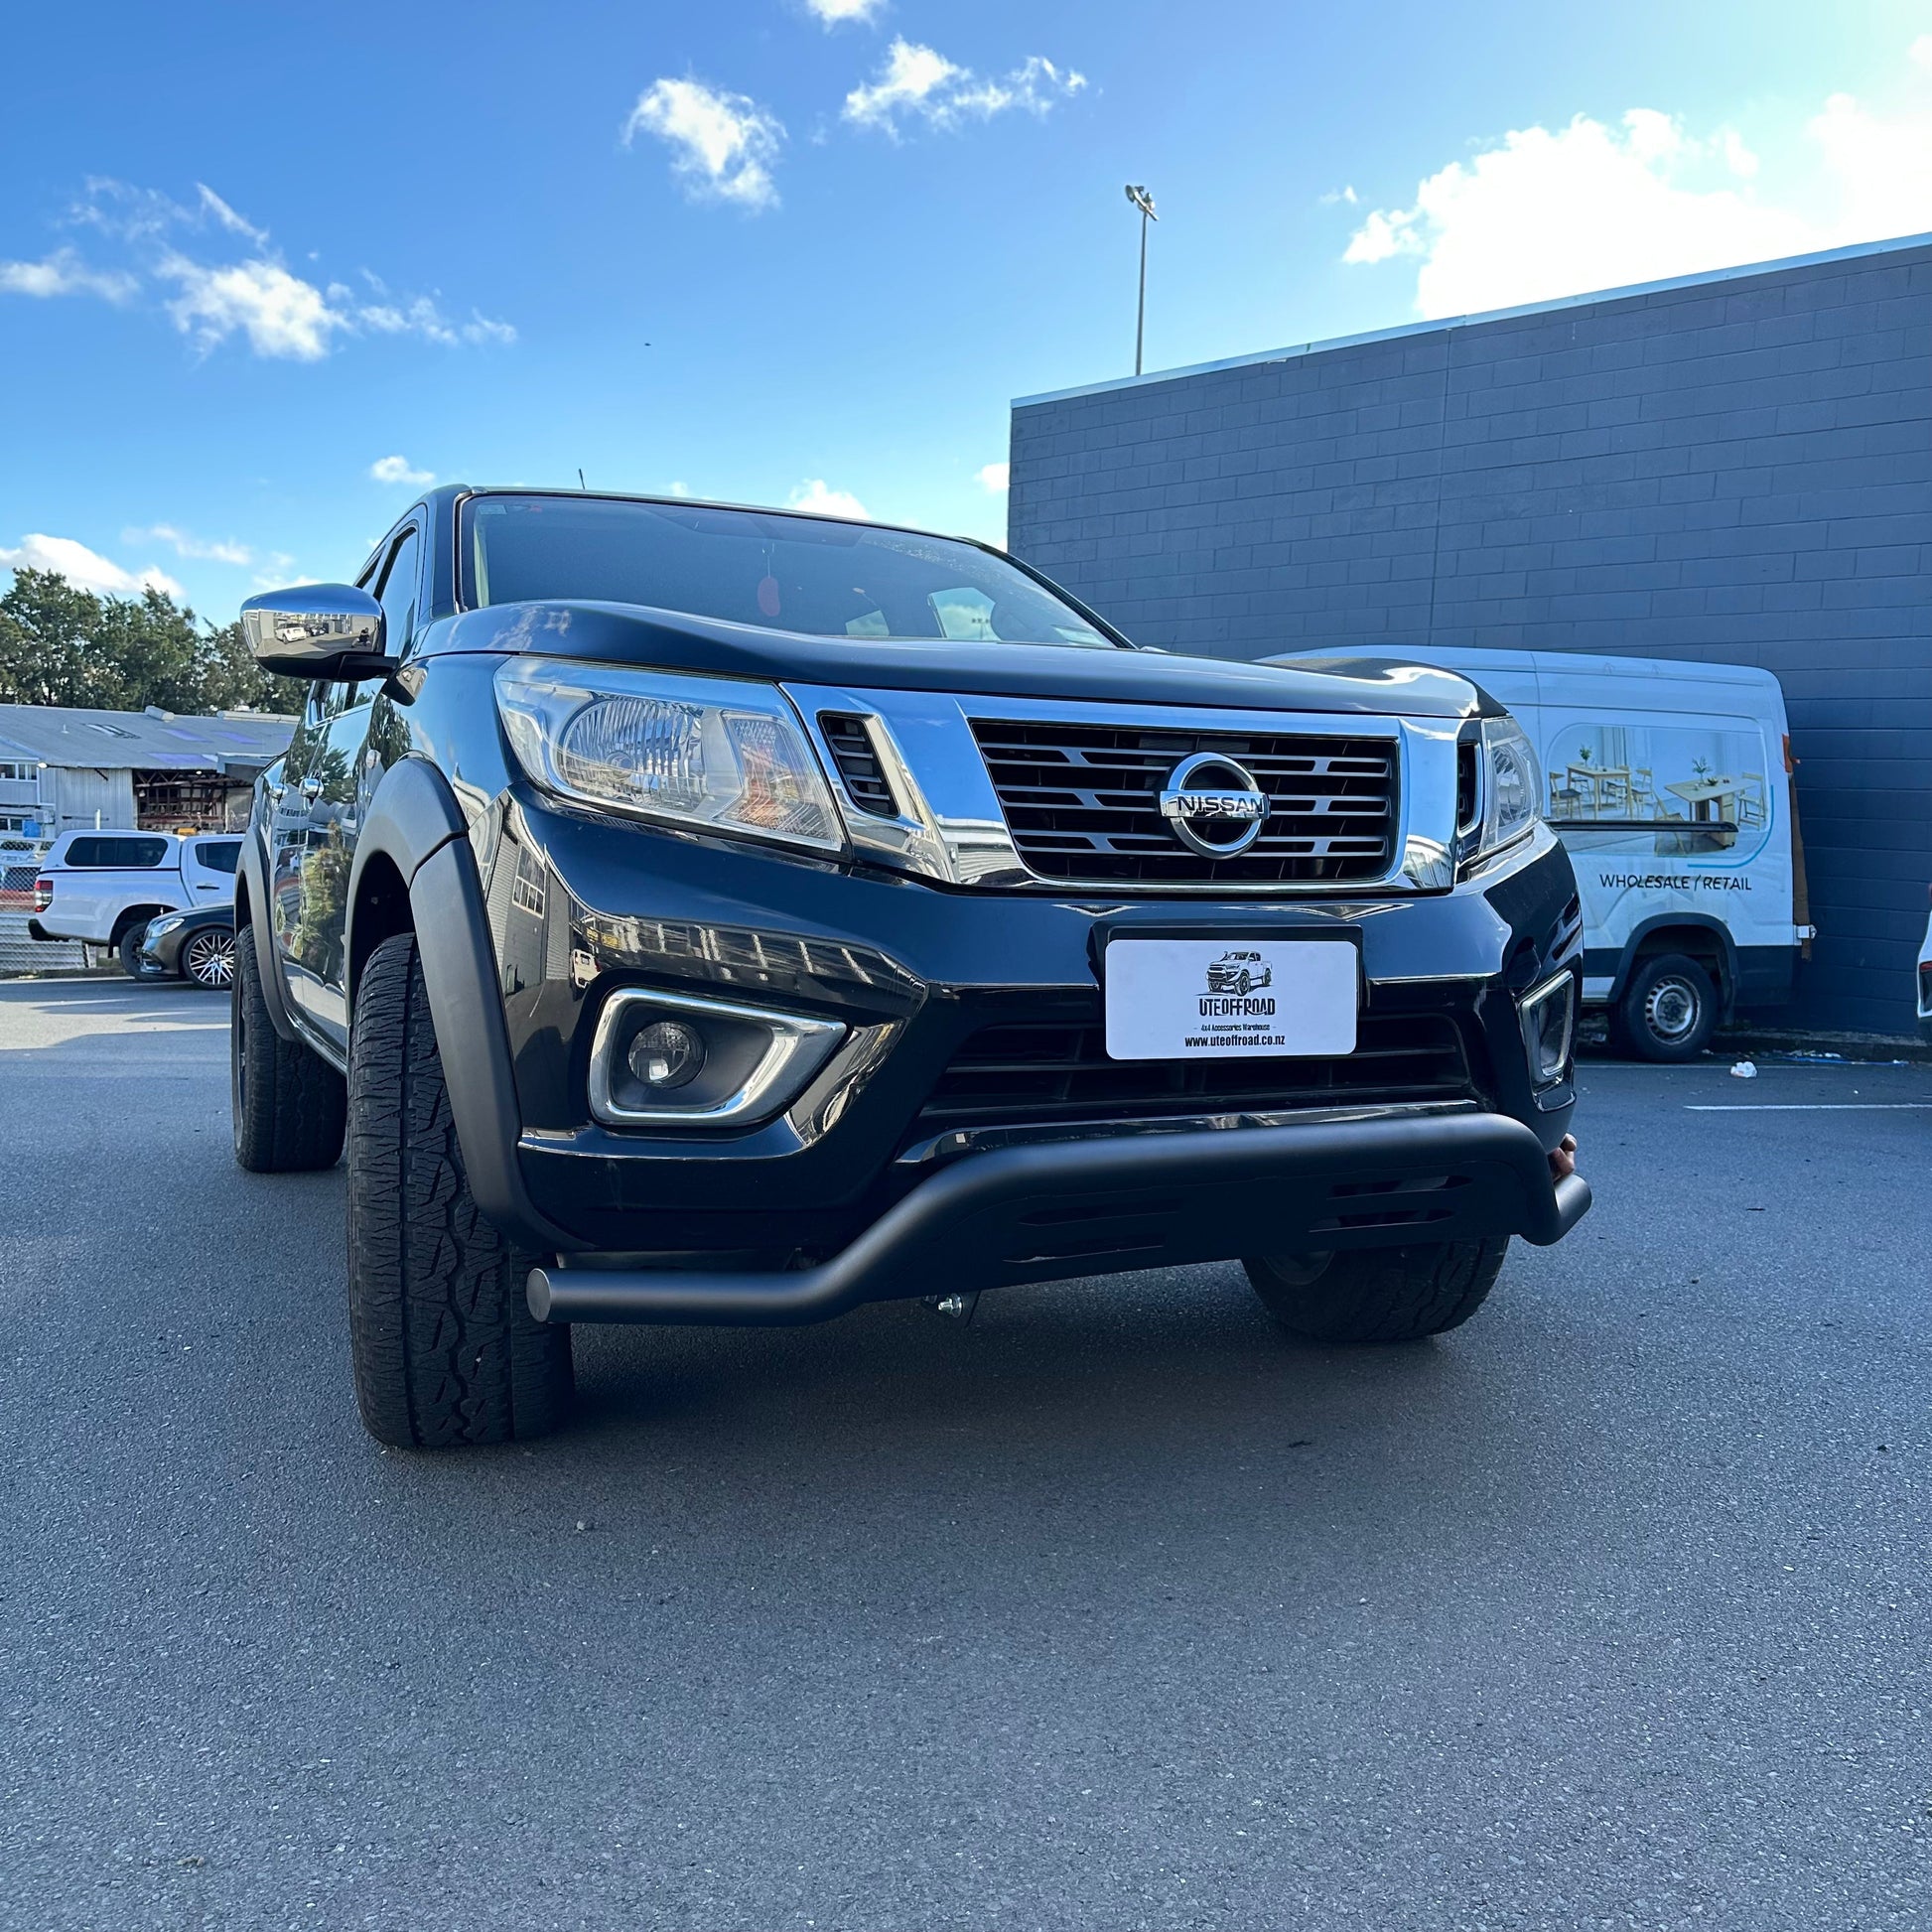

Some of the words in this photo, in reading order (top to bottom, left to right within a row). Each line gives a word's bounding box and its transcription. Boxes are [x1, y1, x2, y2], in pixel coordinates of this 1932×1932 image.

[1177, 796, 1264, 813] NISSAN
[1599, 874, 1690, 890] WHOLESALE
[1703, 876, 1752, 891] RETAIL
[1199, 998, 1276, 1017] UTEOFFROAD
[1184, 1034, 1286, 1047] www.uteoffroad.co.nz
